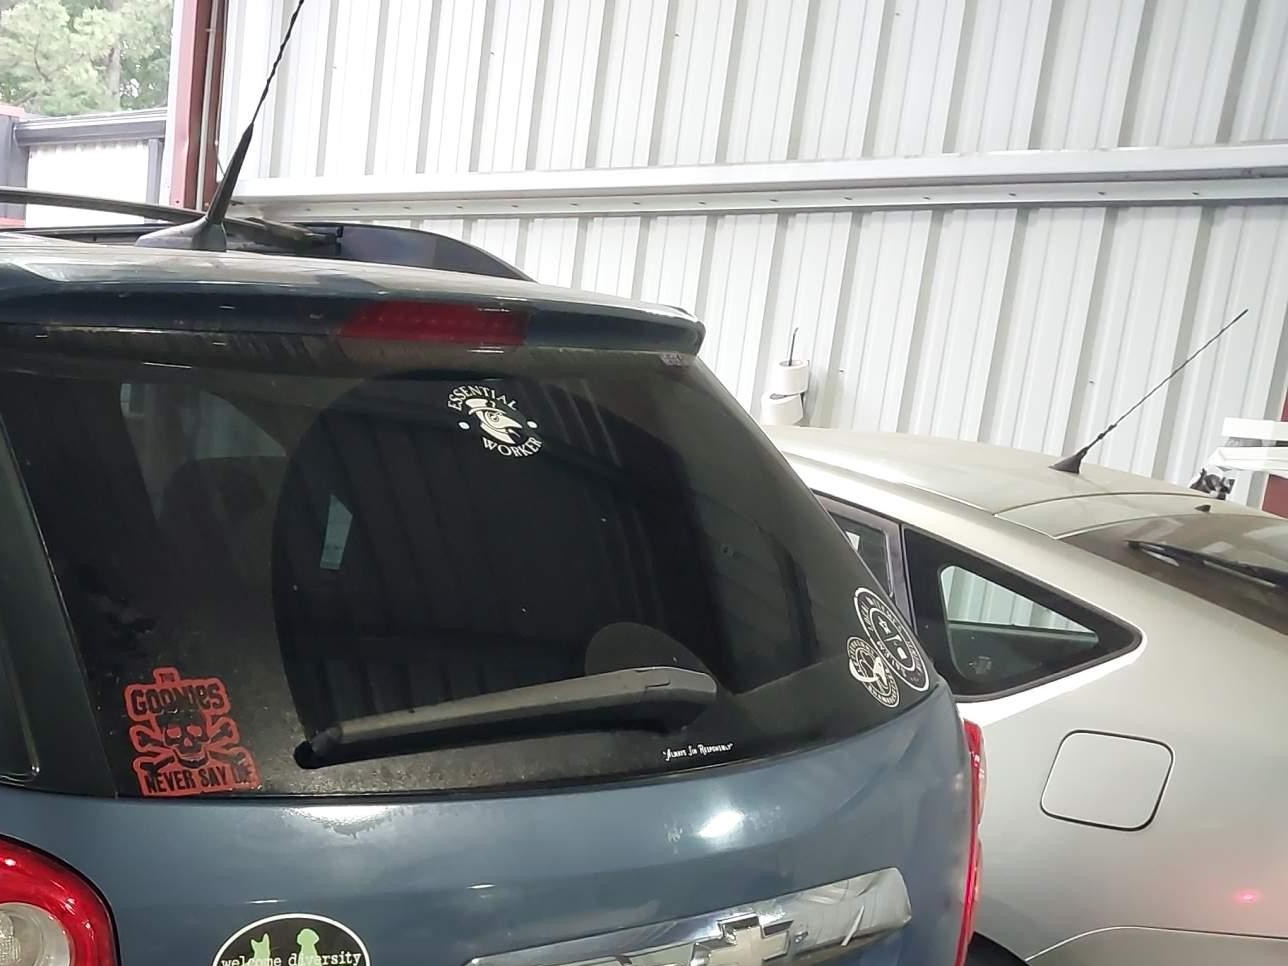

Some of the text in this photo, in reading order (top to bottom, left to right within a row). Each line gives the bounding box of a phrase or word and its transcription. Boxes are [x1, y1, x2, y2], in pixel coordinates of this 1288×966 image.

[447, 385, 517, 411] ESSENTIAL
[482, 436, 542, 457] WORKER
[144, 769, 196, 793] NEVER
[198, 766, 228, 787] SAY
[288, 950, 362, 966] diversity
